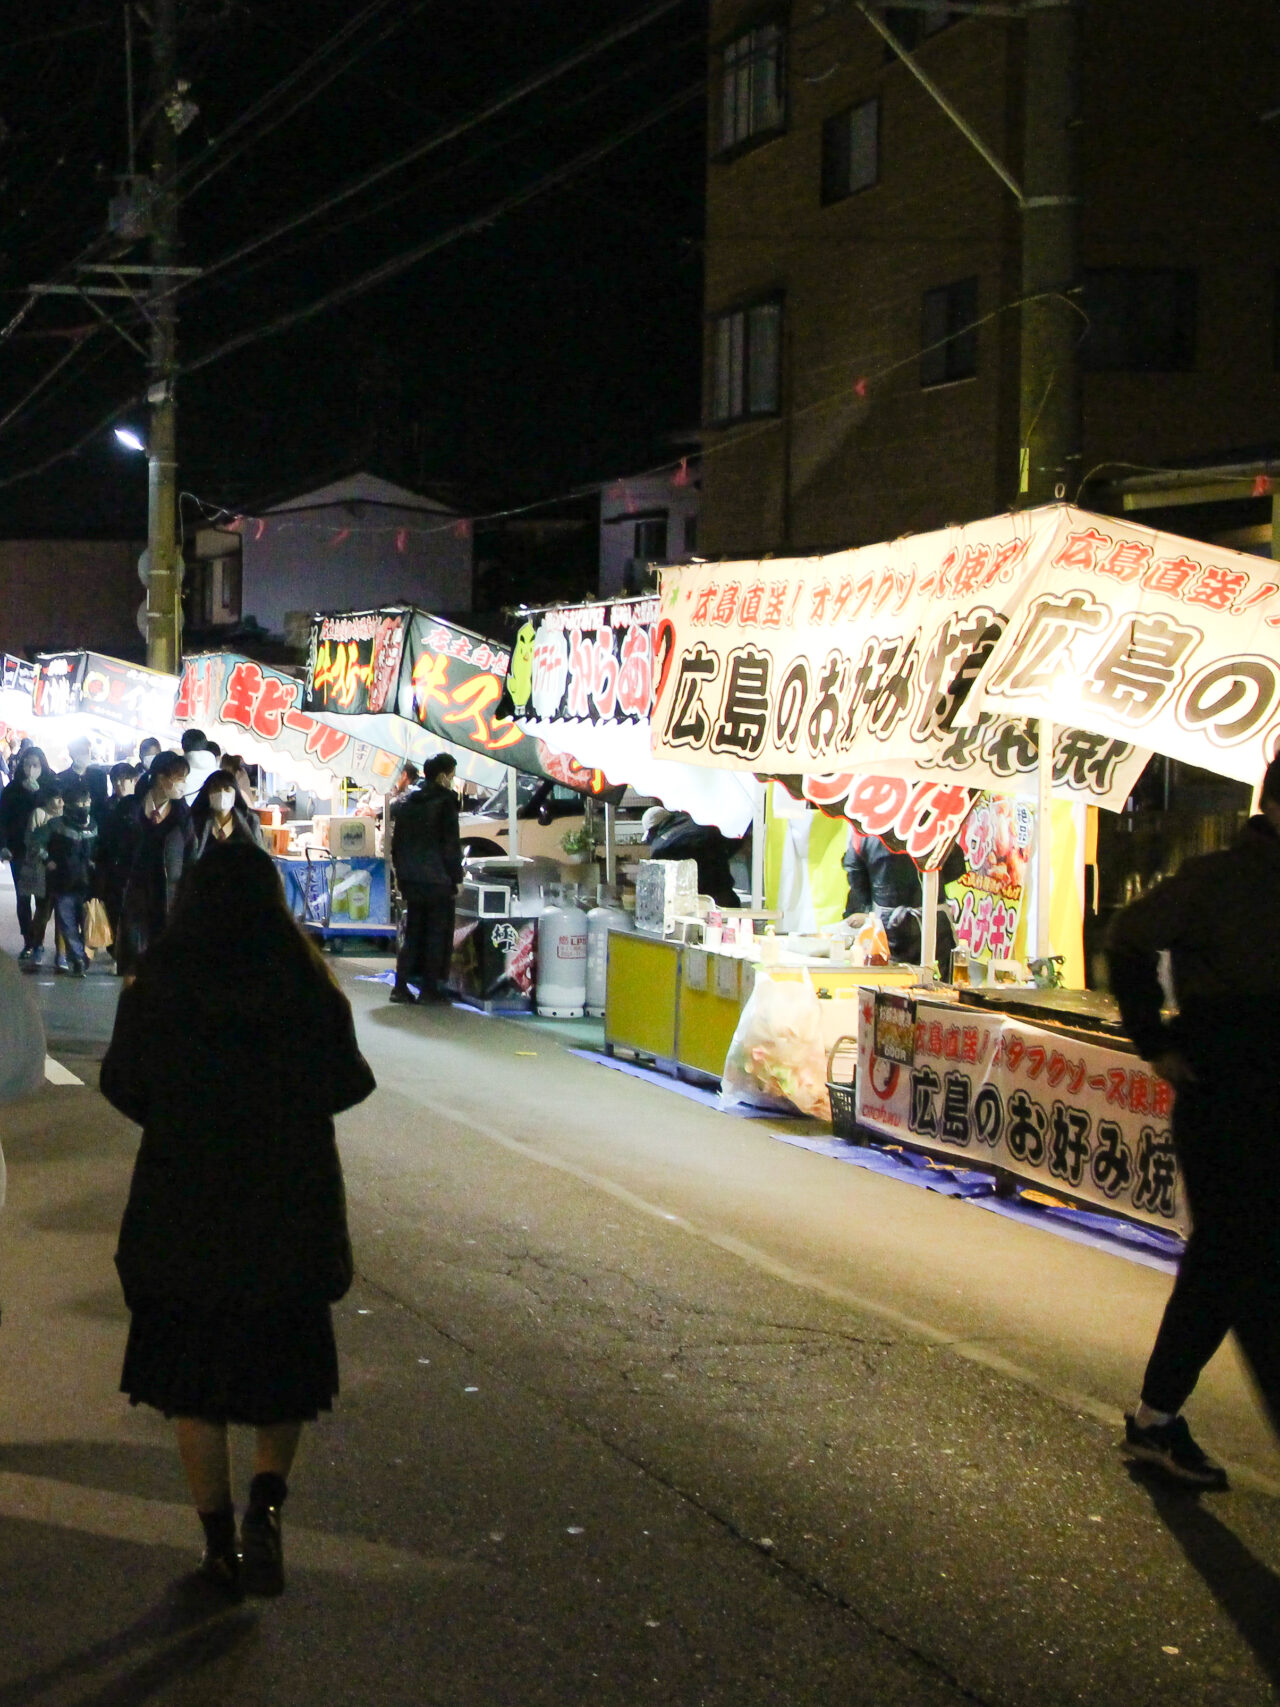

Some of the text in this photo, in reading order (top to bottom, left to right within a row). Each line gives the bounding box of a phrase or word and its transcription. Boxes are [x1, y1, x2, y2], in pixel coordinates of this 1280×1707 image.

[690, 579, 805, 627] 広島直送!
[1052, 528, 1279, 615] 広島直送!
[220, 661, 350, 763] 生ビール
[568, 623, 661, 720] からあ
[986, 589, 1280, 766] 広島の
[908, 1063, 1176, 1219] 広島のお好み焼
